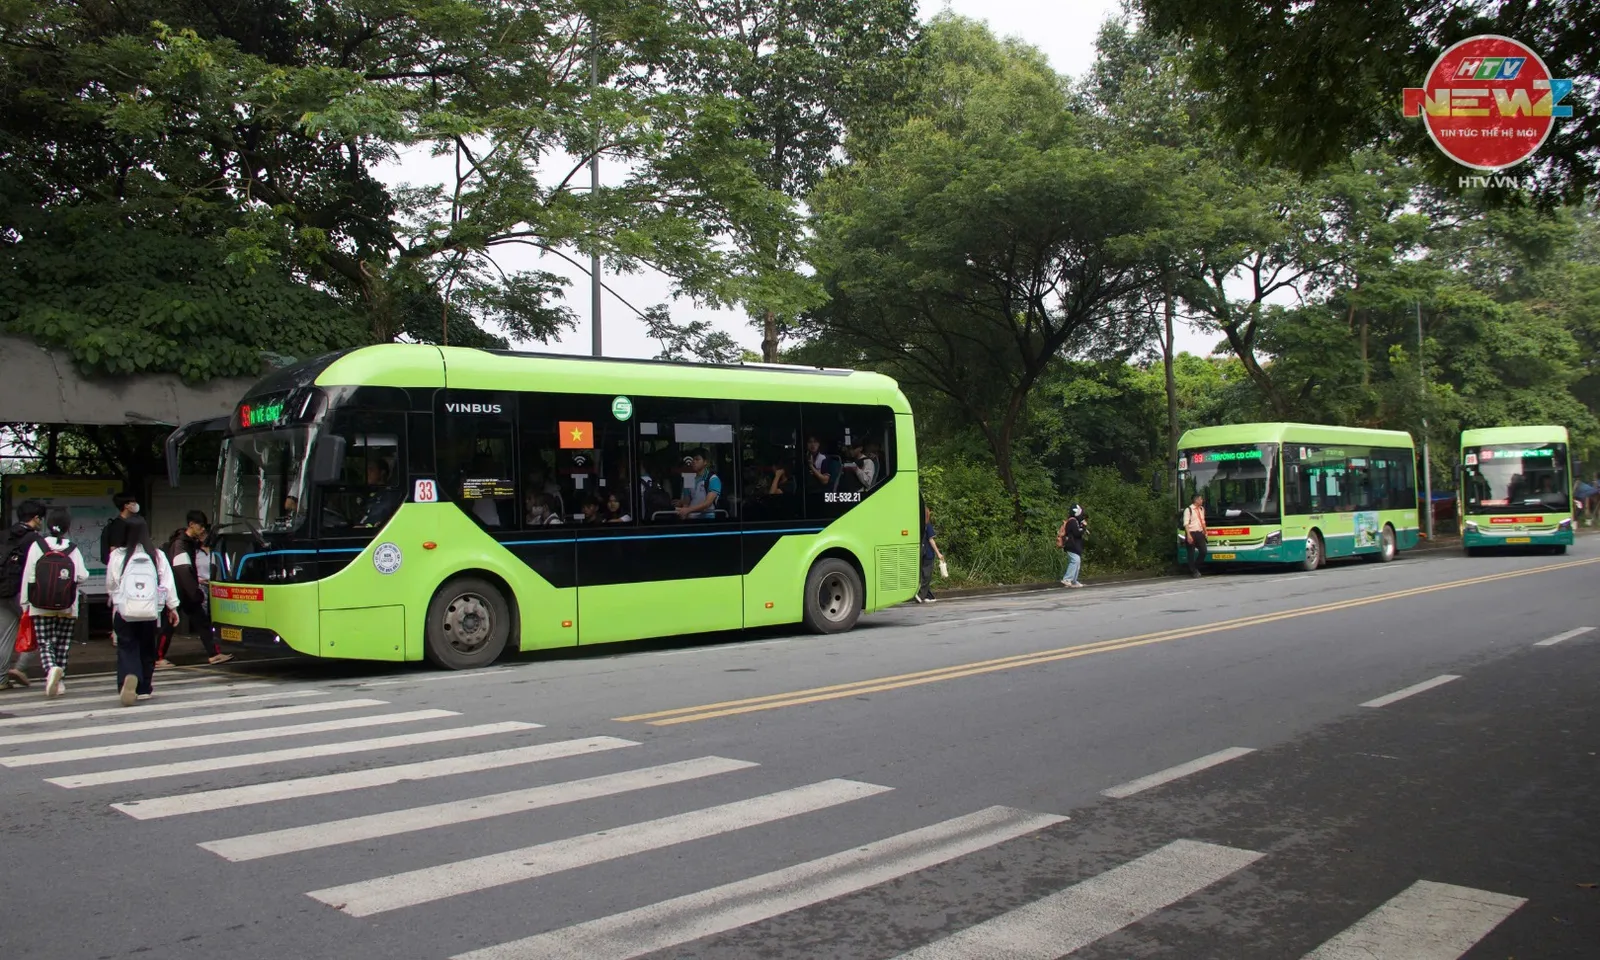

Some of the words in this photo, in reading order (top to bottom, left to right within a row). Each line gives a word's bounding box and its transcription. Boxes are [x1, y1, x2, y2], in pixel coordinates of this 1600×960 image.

[445, 403, 502, 413] VINBUS
[418, 481, 433, 500] 33
[824, 492, 861, 503] 50E-532.21
